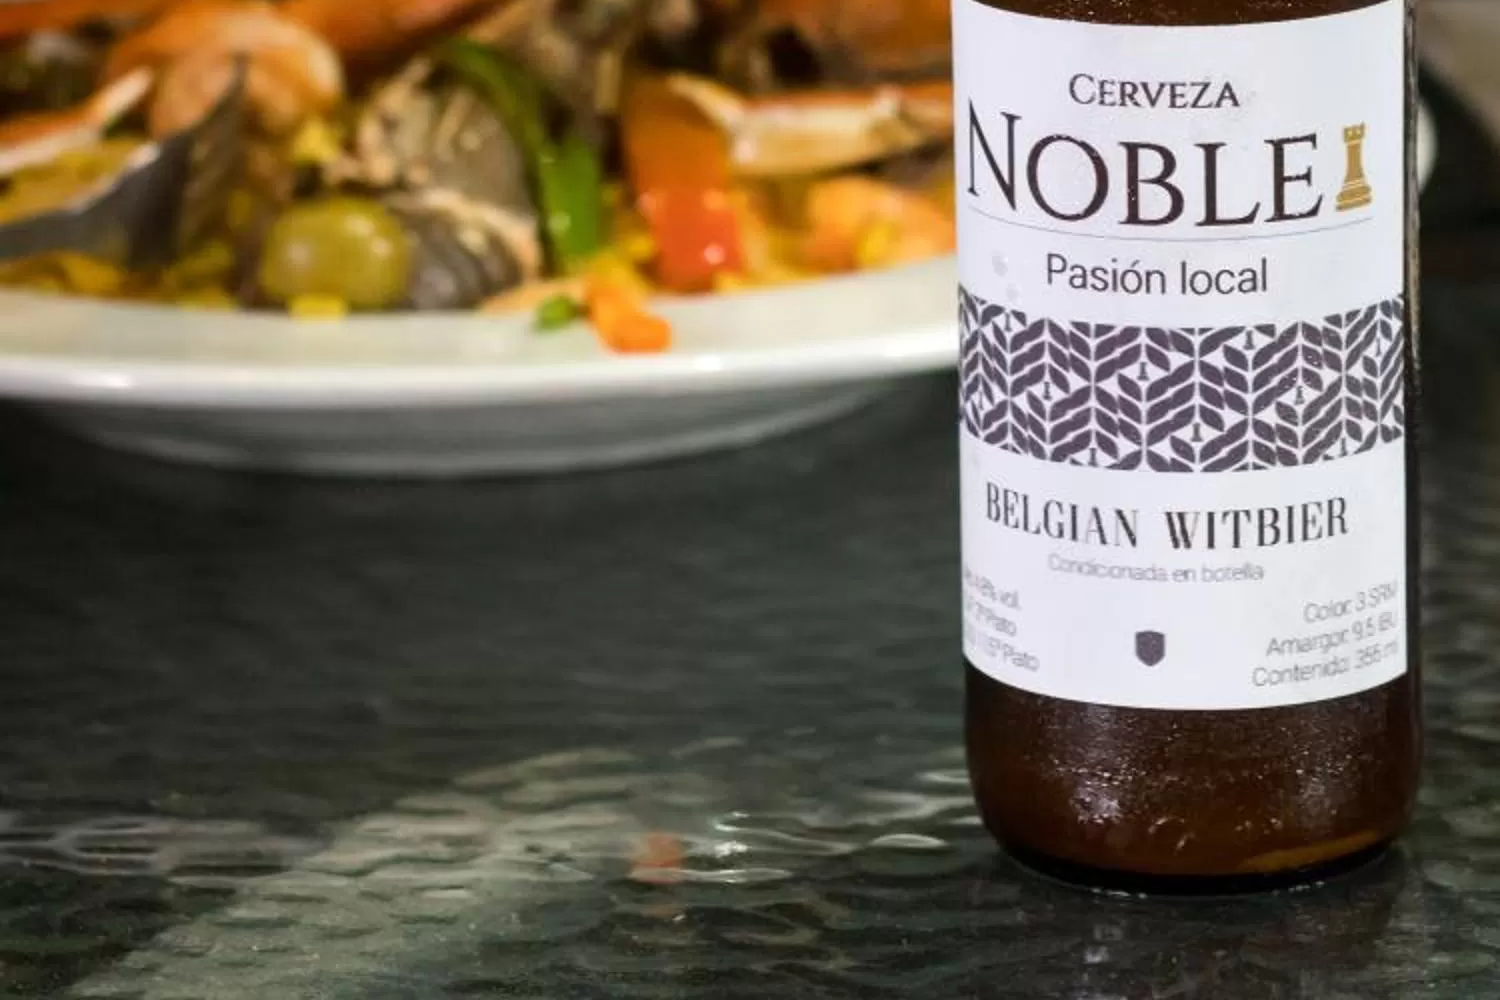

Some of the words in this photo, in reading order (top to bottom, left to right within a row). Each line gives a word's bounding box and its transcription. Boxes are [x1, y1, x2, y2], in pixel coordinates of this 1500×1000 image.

[1069, 73, 1240, 109] CERVEZA
[967, 99, 1323, 227] NOBLE
[1047, 253, 1167, 295] Pasión
[1181, 257, 1268, 296] local
[986, 481, 1140, 548] BELGIAN
[1164, 496, 1350, 550] WITBIER
[1047, 552, 1169, 582] Condicionada
[1172, 567, 1197, 583] en
[1201, 561, 1265, 583] botella
[1355, 590, 1367, 612] 3
[1353, 643, 1382, 669] 355
